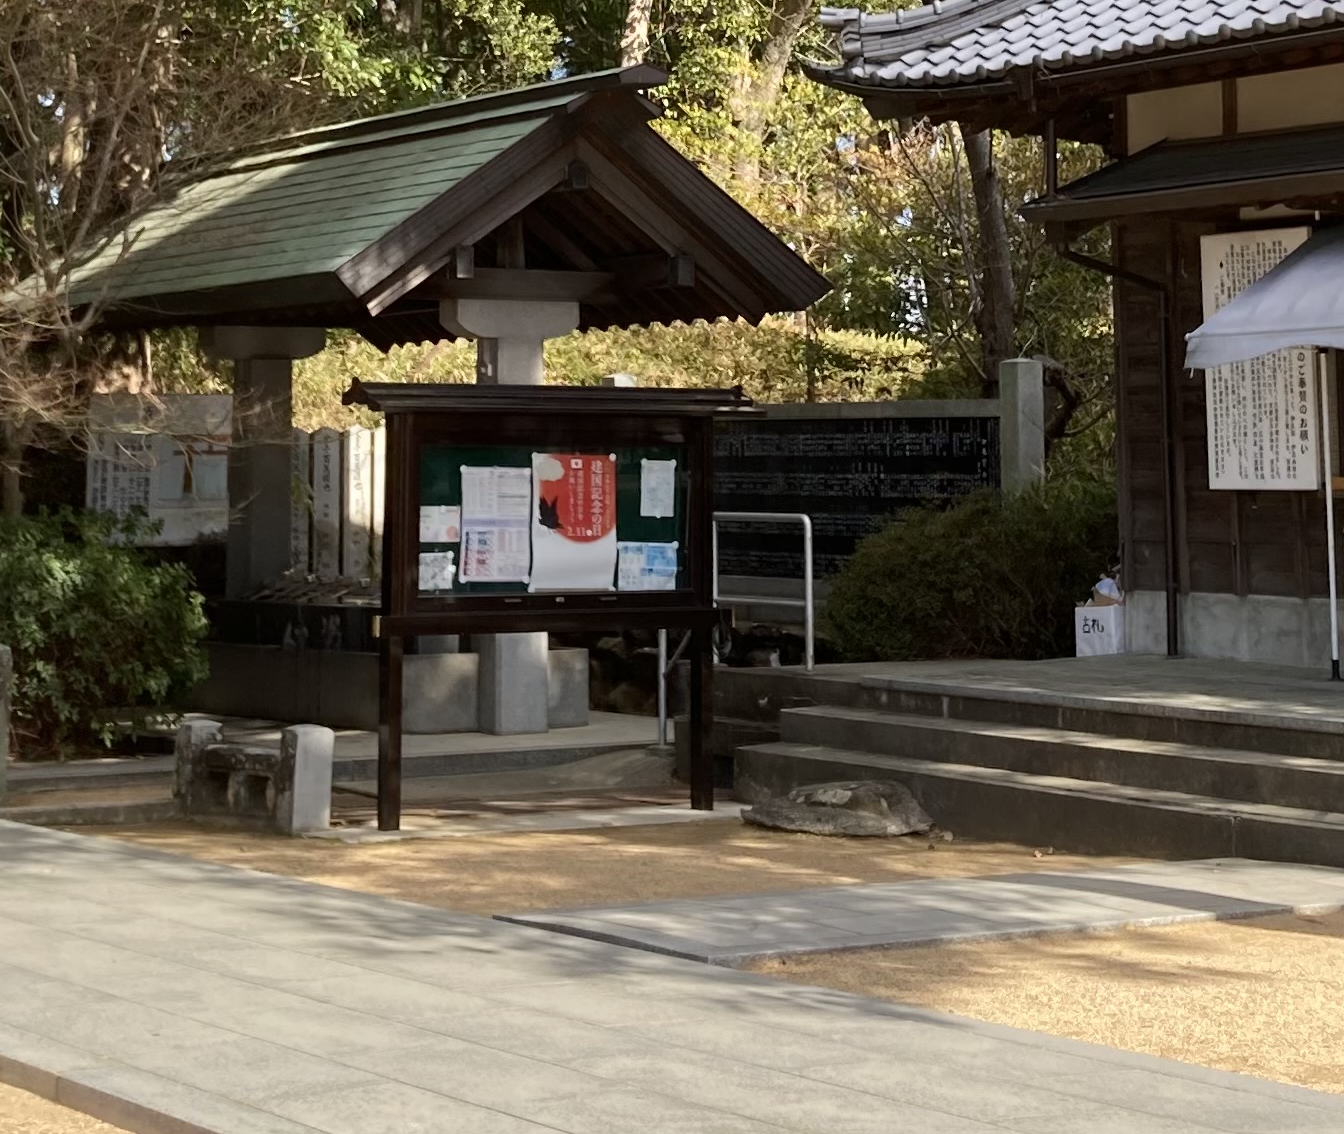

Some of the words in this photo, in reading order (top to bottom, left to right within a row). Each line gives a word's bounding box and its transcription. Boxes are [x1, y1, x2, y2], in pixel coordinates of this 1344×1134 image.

[590, 459, 604, 537] 建国記念の日
[1082, 615, 1104, 634] 古札
